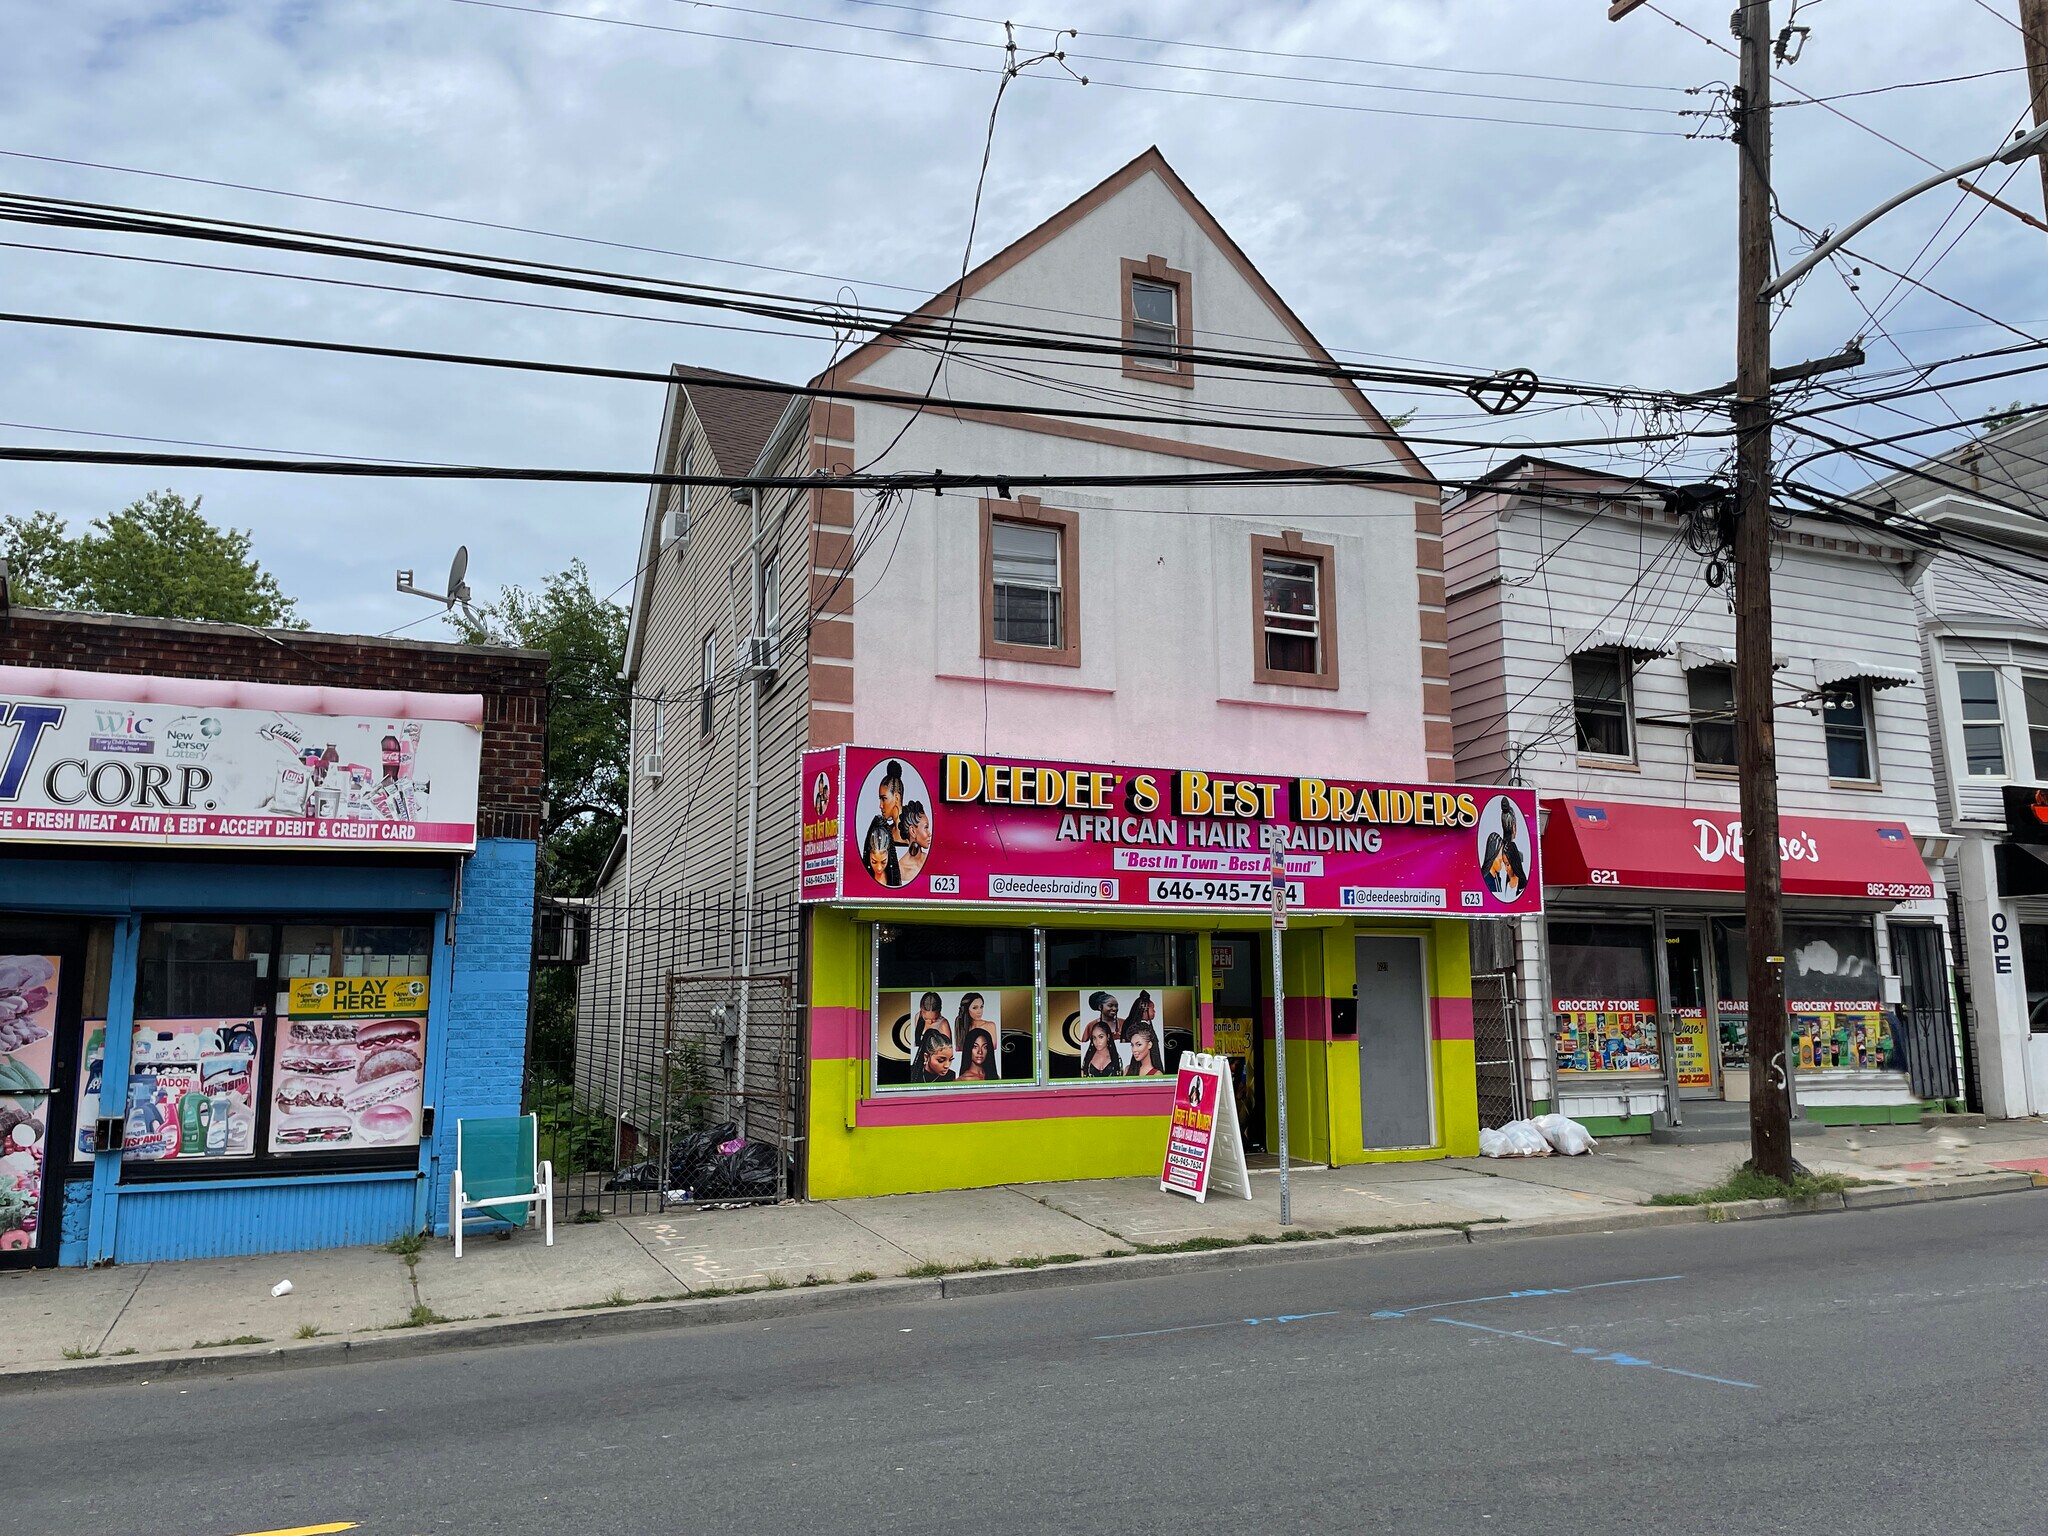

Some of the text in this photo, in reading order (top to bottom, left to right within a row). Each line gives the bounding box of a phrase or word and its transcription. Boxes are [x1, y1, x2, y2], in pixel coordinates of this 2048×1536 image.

[167, 730, 194, 740] New
[172, 740, 209, 751] Jersey
[166, 749, 208, 761] Lottery
[43, 758, 217, 811] CORP.
[1179, 770, 1280, 819] BEST
[1298, 778, 1479, 828] BRAIDERS
[27, 812, 74, 829] FRESH
[78, 813, 118, 830] MEAT
[130, 815, 159, 832] ATM
[164, 816, 175, 833] &
[179, 817, 207, 833] EBT
[219, 818, 273, 836] ACCEPT
[275, 820, 315, 837] DEBIT
[318, 822, 328, 837] &
[331, 822, 378, 839] CREDIT
[381, 824, 416, 840] CARD
[1057, 814, 1178, 845] AFRICAN
[1188, 822, 1251, 848] HAIR
[1692, 818, 1820, 864] DiBse's
[1164, 855, 1177, 869] In
[1181, 854, 1218, 870] Town
[1229, 856, 1261, 871] Best
[935, 878, 955, 891] 623
[1591, 870, 1620, 885] 621
[993, 878, 1098, 897] @deedeesbraiding
[1157, 881, 1297, 902] 646-945-764
[1867, 883, 1932, 898] 862-229-2228
[1356, 889, 1441, 906] @deedeesbraiding
[1465, 893, 1480, 905] 623
[1212, 955, 1232, 966] PEN
[334, 980, 388, 995] PLAY
[333, 995, 387, 1010] HERE
[1558, 1000, 1640, 1011] GROCERY STORE
[1791, 1001, 1833, 1012] GROCERY
[1671, 1008, 1702, 1018] ECOME
[1170, 1155, 1202, 1170] 646-945-7634
